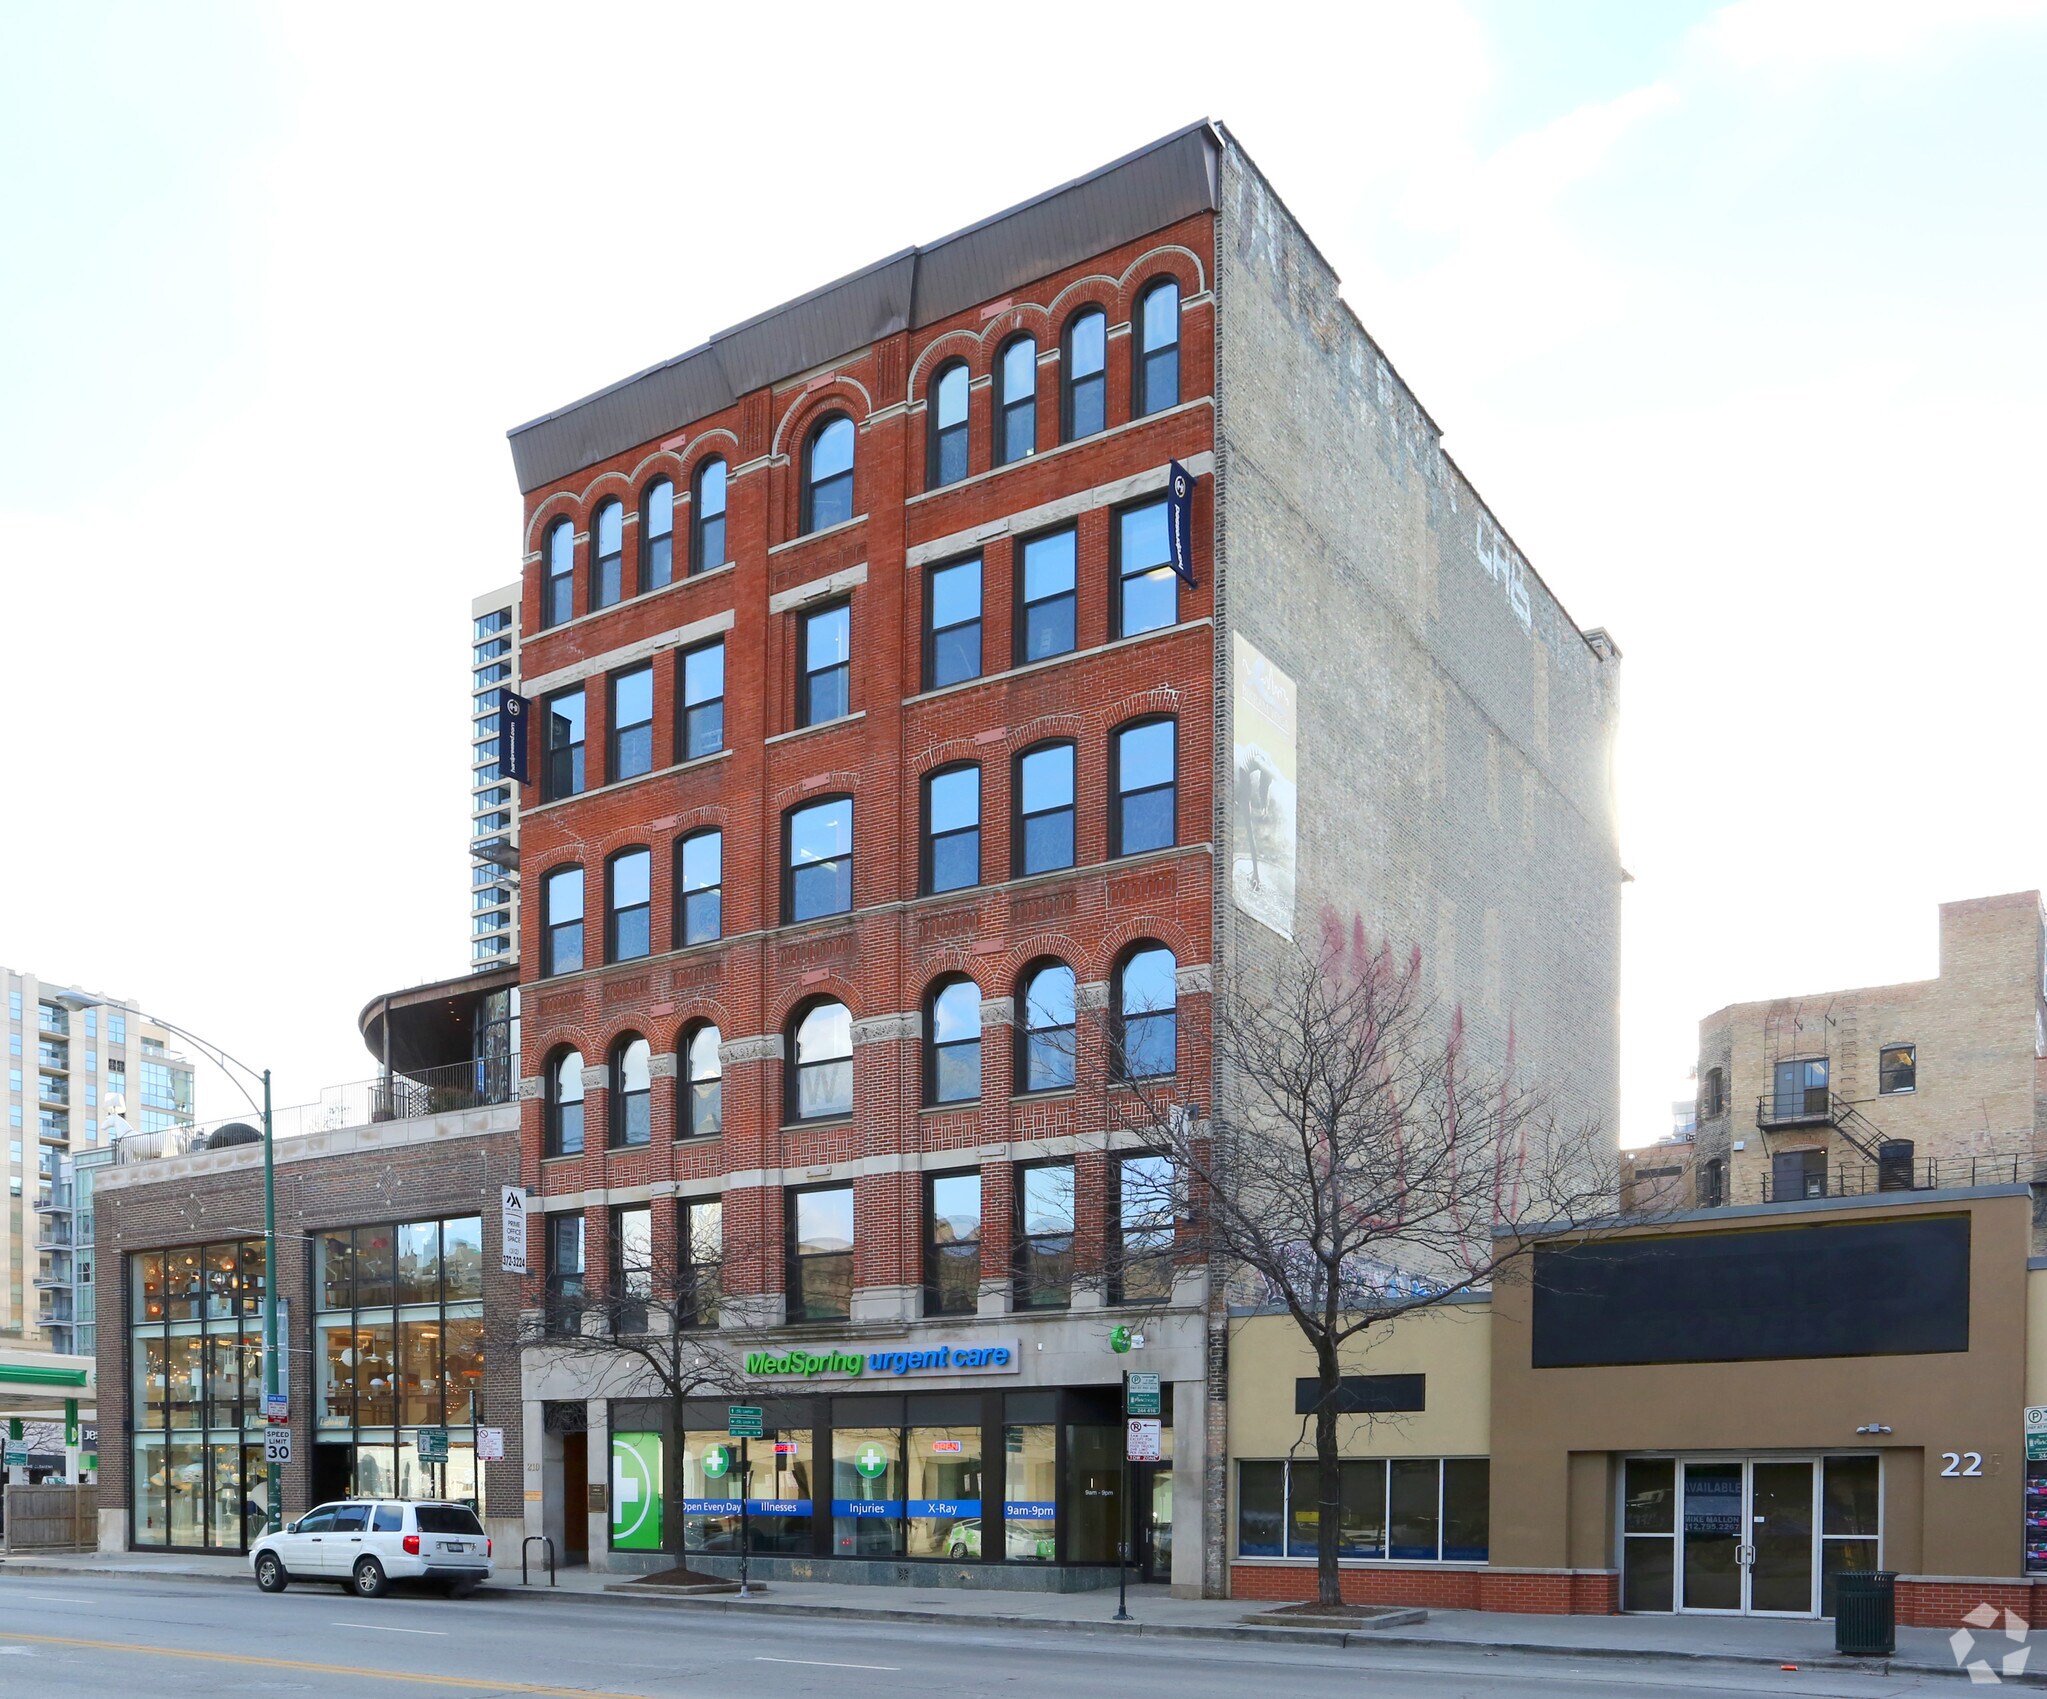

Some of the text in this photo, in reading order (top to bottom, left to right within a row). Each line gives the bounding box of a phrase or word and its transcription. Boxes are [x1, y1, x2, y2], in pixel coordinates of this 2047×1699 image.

[507, 1219, 521, 1229] PRIME
[506, 1227, 522, 1237] OFFICE
[507, 1235, 521, 1244] SPACE
[502, 1255, 525, 1268] 372-3224
[744, 1346, 1010, 1377] MedSpring urgent care
[267, 1445, 289, 1459] 30
[772, 1444, 795, 1453] OPEN
[932, 1442, 959, 1451] OPEN
[1684, 1482, 1742, 1493] AVAILABLE
[683, 1502, 742, 1513] Open Every Day
[761, 1502, 797, 1512] Illnesses
[849, 1503, 885, 1515] Injuries
[927, 1503, 958, 1515] X-Ray
[1006, 1503, 1054, 1517] 9am-9pm
[1685, 1515, 1704, 1523] MIKE
